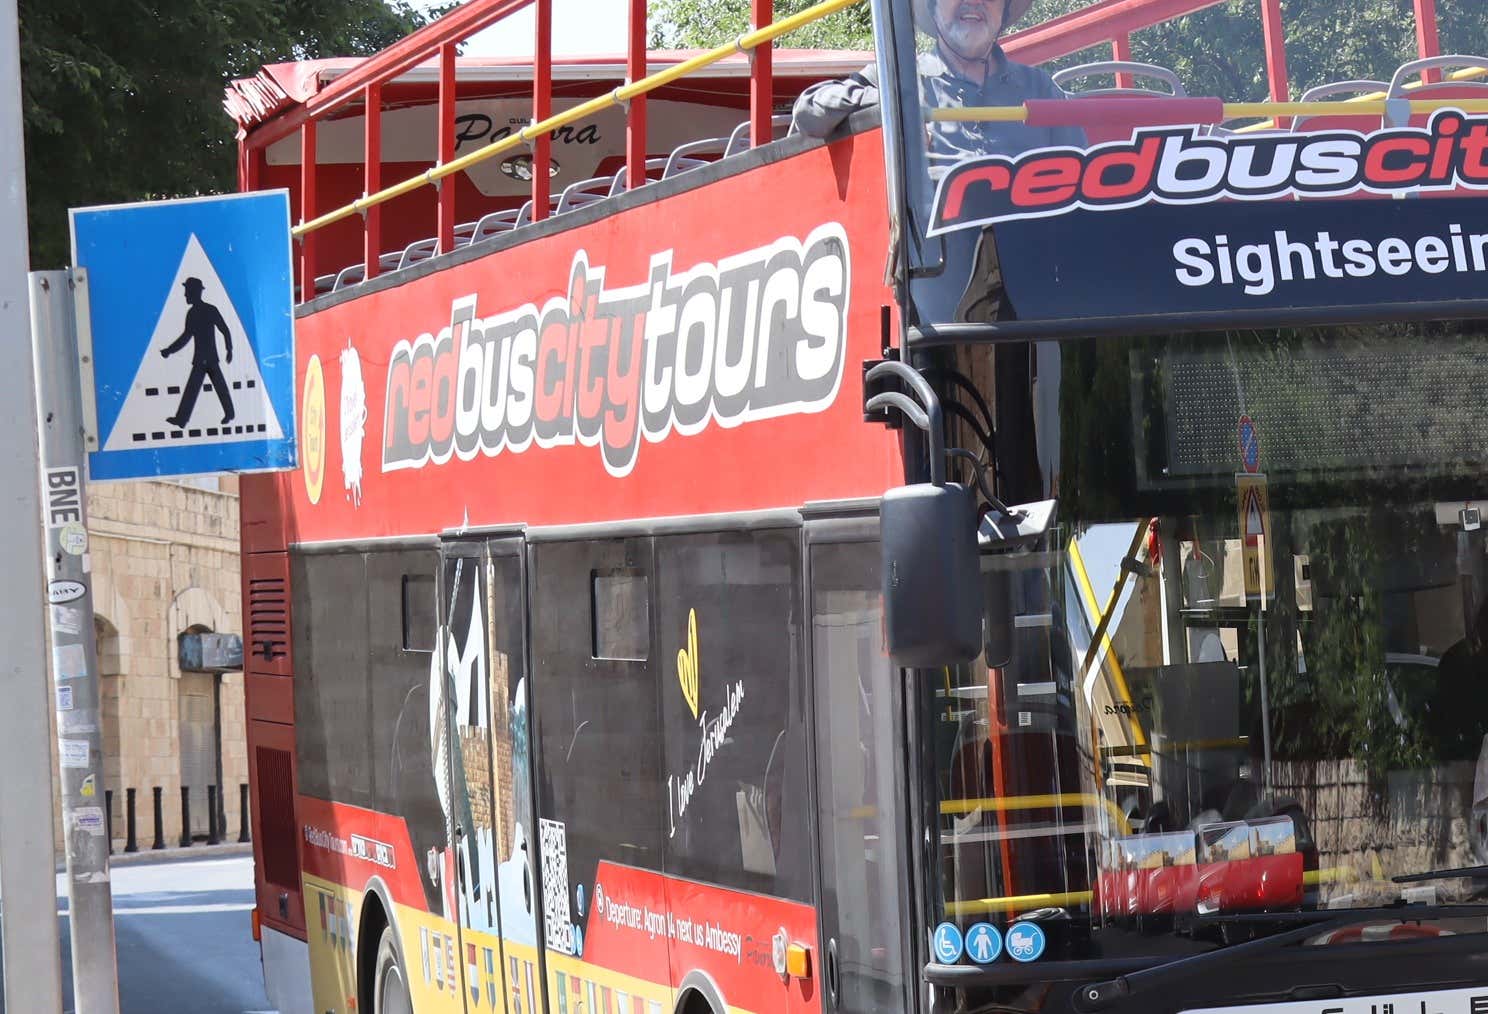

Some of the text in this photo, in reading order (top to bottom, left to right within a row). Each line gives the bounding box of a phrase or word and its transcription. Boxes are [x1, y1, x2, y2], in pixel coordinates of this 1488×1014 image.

[385, 244, 846, 455] redbuscitytours
[47, 470, 80, 525] BNE
[668, 679, 745, 838] I love Jerusalem
[644, 905, 666, 940] Agron
[676, 917, 693, 944] next
[705, 921, 742, 966] Ambessy
